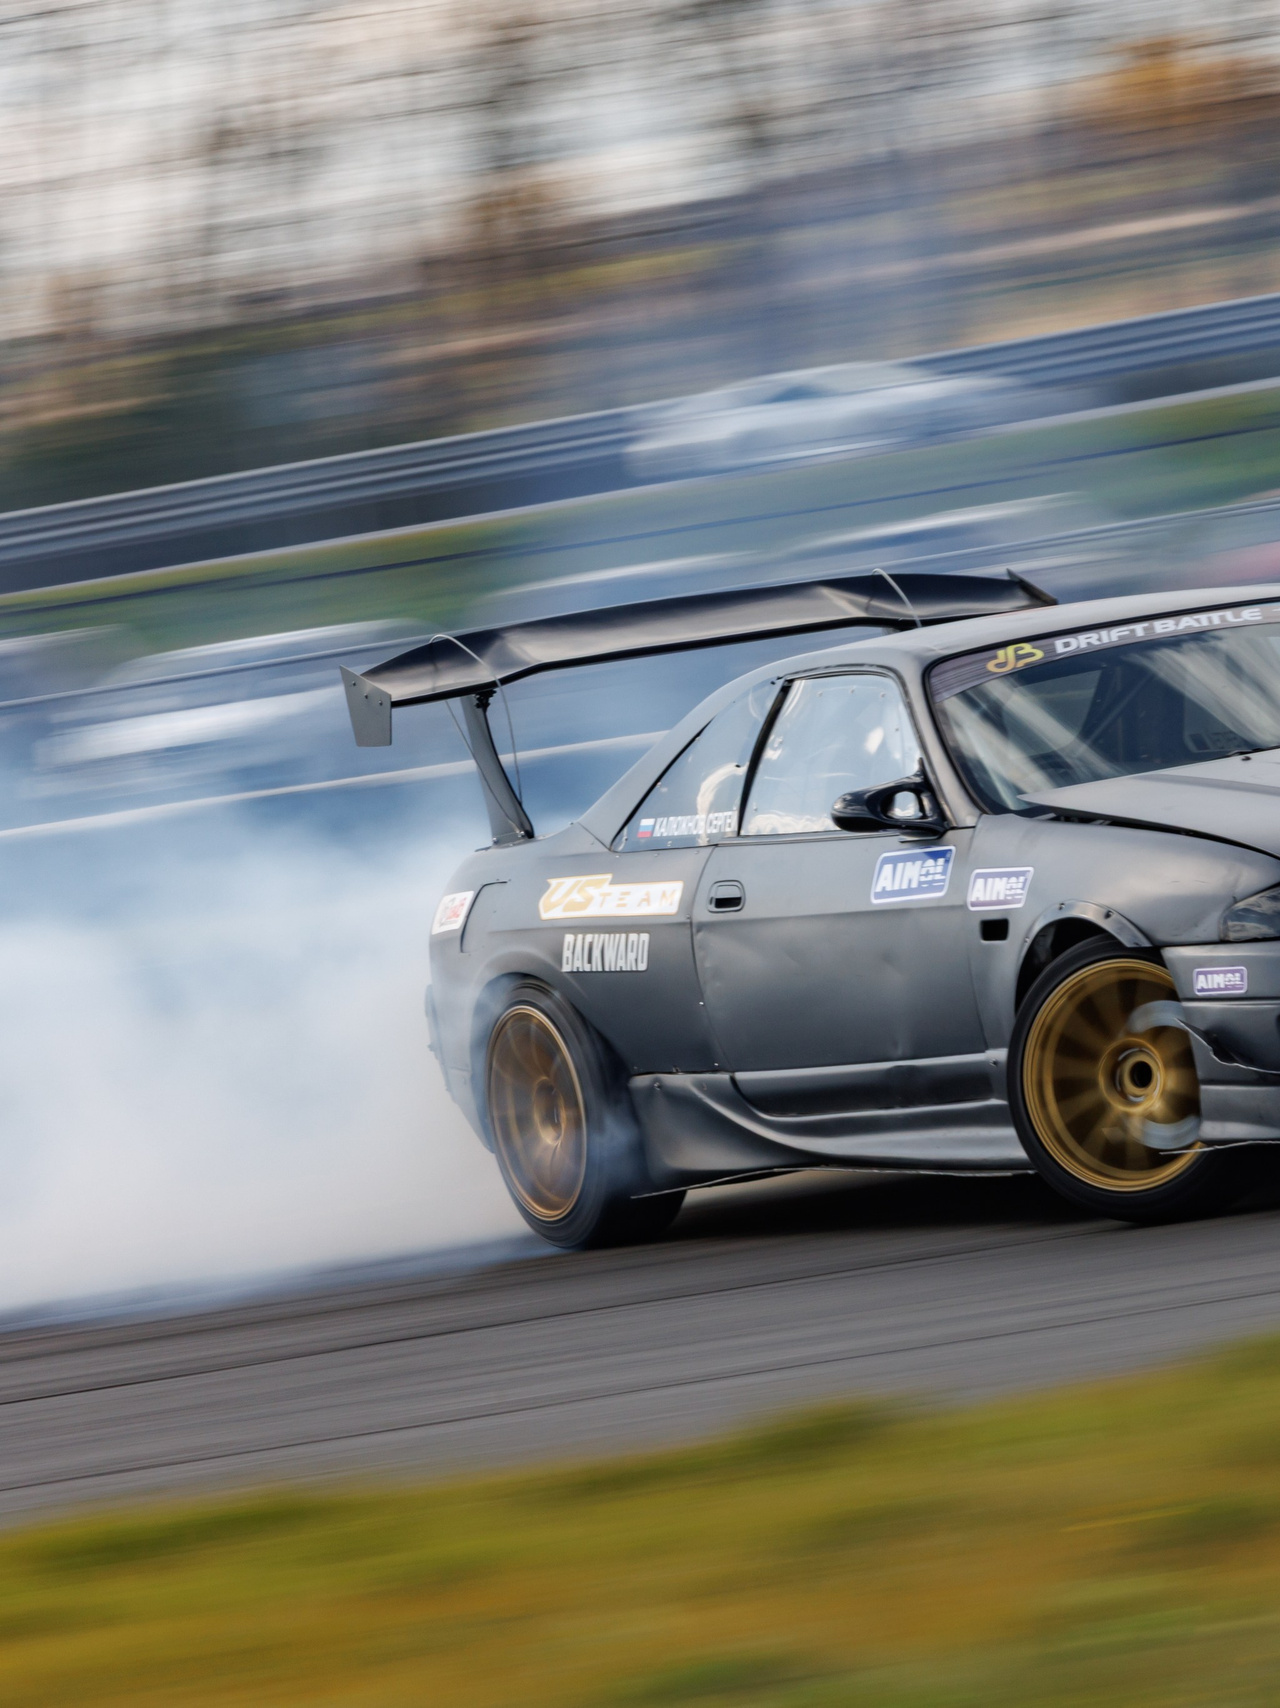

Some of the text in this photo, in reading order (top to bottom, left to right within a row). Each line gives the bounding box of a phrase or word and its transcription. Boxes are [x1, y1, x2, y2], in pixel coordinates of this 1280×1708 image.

[1054, 623, 1150, 653] DRIFT
[1154, 608, 1263, 634] BATTLE
[875, 858, 946, 892] AIMOL
[971, 876, 1025, 901] AIMOL
[599, 889, 677, 908] TEAM
[561, 933, 650, 972] BACKWARD
[1197, 973, 1244, 989] AIMOL
